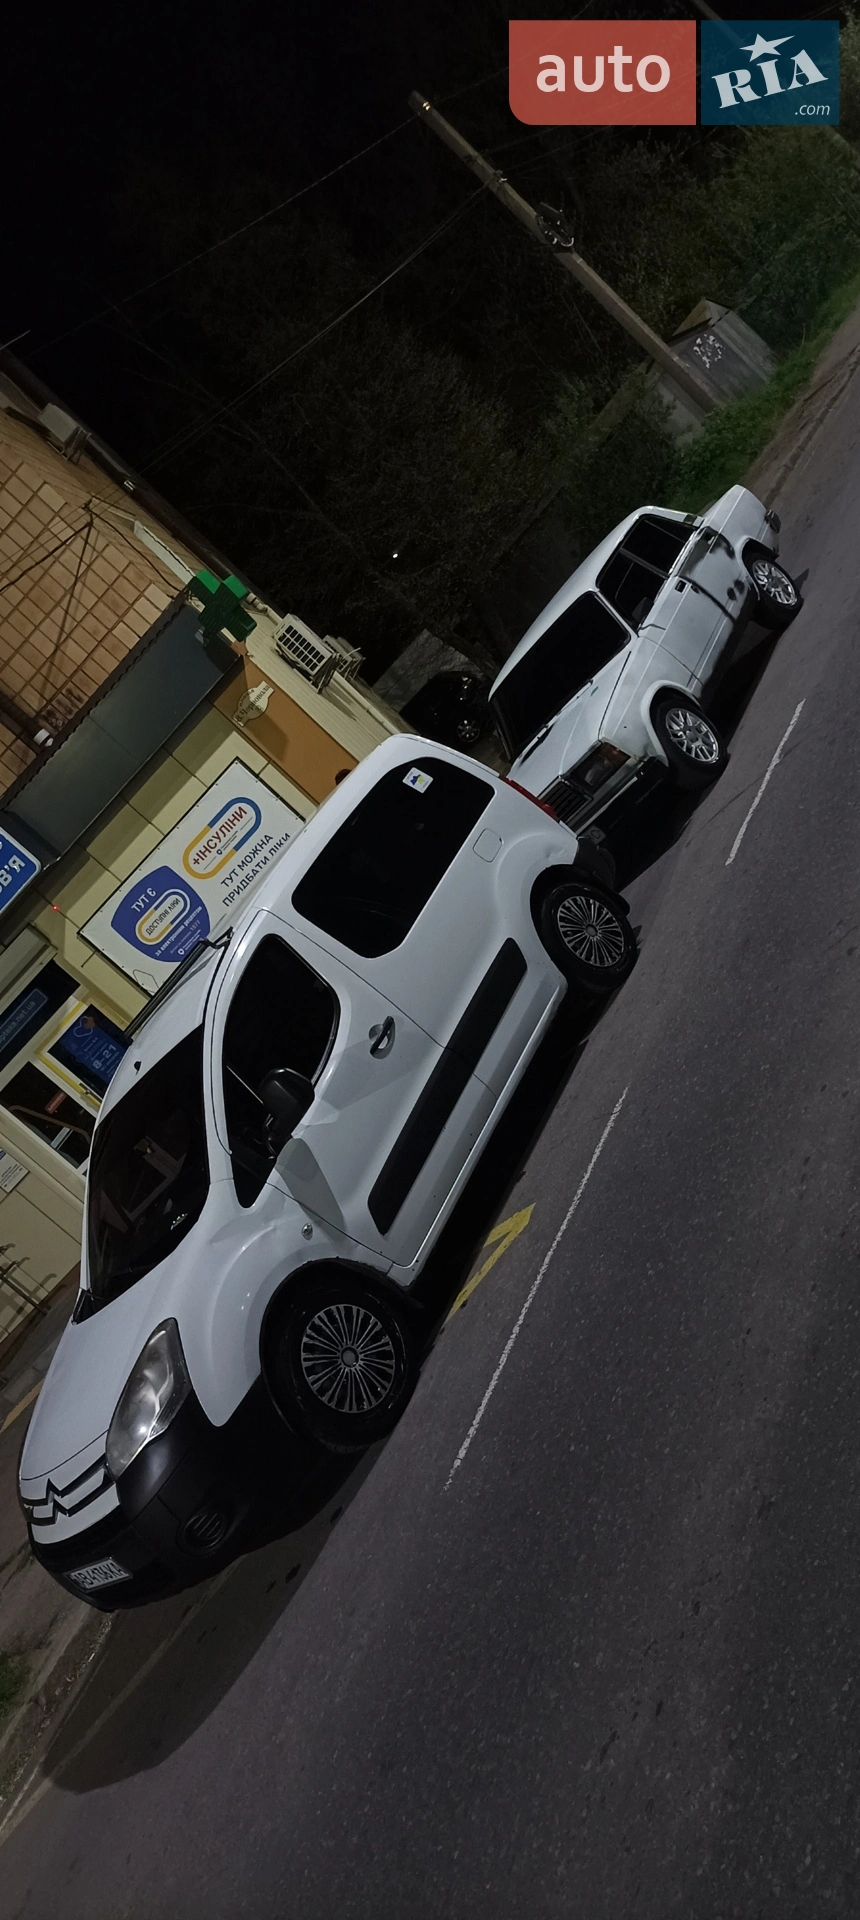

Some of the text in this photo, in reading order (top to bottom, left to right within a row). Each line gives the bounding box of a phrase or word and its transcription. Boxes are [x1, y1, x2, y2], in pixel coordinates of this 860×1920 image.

[220, 868, 239, 887] ТУТ
[237, 834, 273, 870] МОЖНА
[222, 855, 269, 907] ПРИДБАТИ
[268, 832, 290, 856] ЛІКИ
[131, 886, 157, 913] ТУТ Є
[144, 908, 170, 935] ДОСТУПНІ
[167, 897, 180, 911] ЛІКИ
